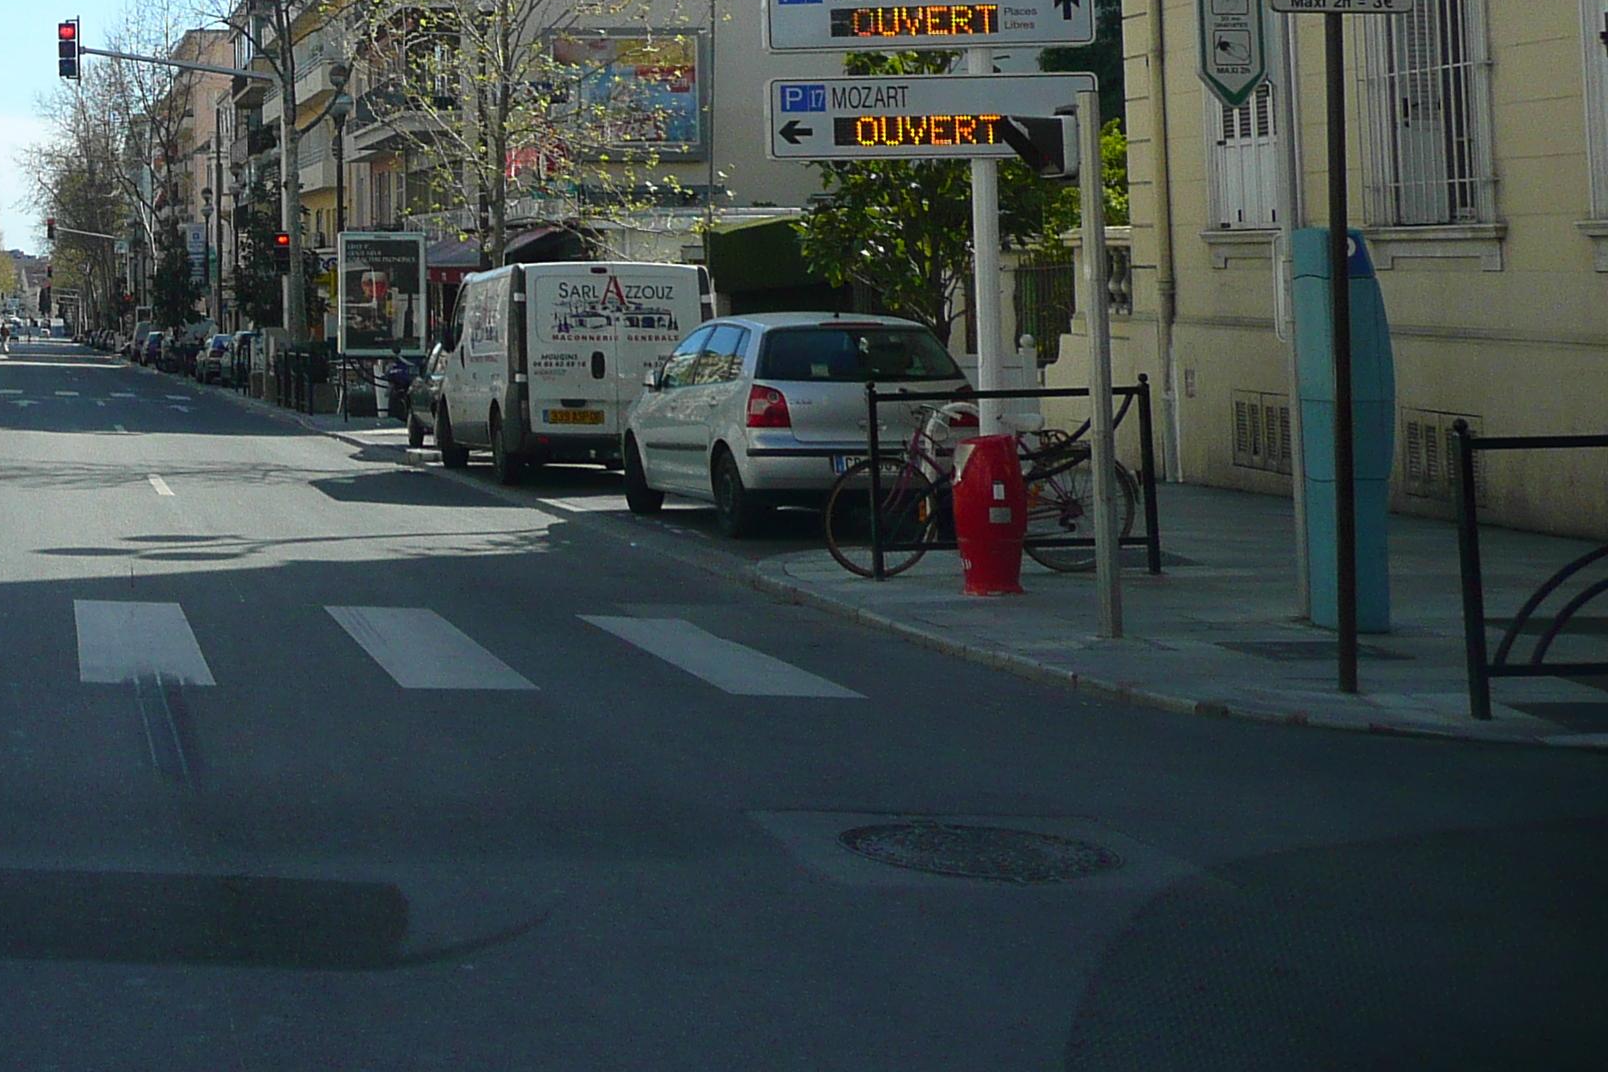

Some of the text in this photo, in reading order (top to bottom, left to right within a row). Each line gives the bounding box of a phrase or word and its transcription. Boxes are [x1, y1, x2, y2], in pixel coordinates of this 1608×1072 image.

[853, 5, 996, 36] OUVERT
[1004, 7, 1038, 17] Places
[1004, 19, 1035, 30] Libres
[785, 85, 908, 109] P 17 MOZART
[856, 115, 1001, 146] OUVERT
[600, 275, 674, 305] AZZOUZ
